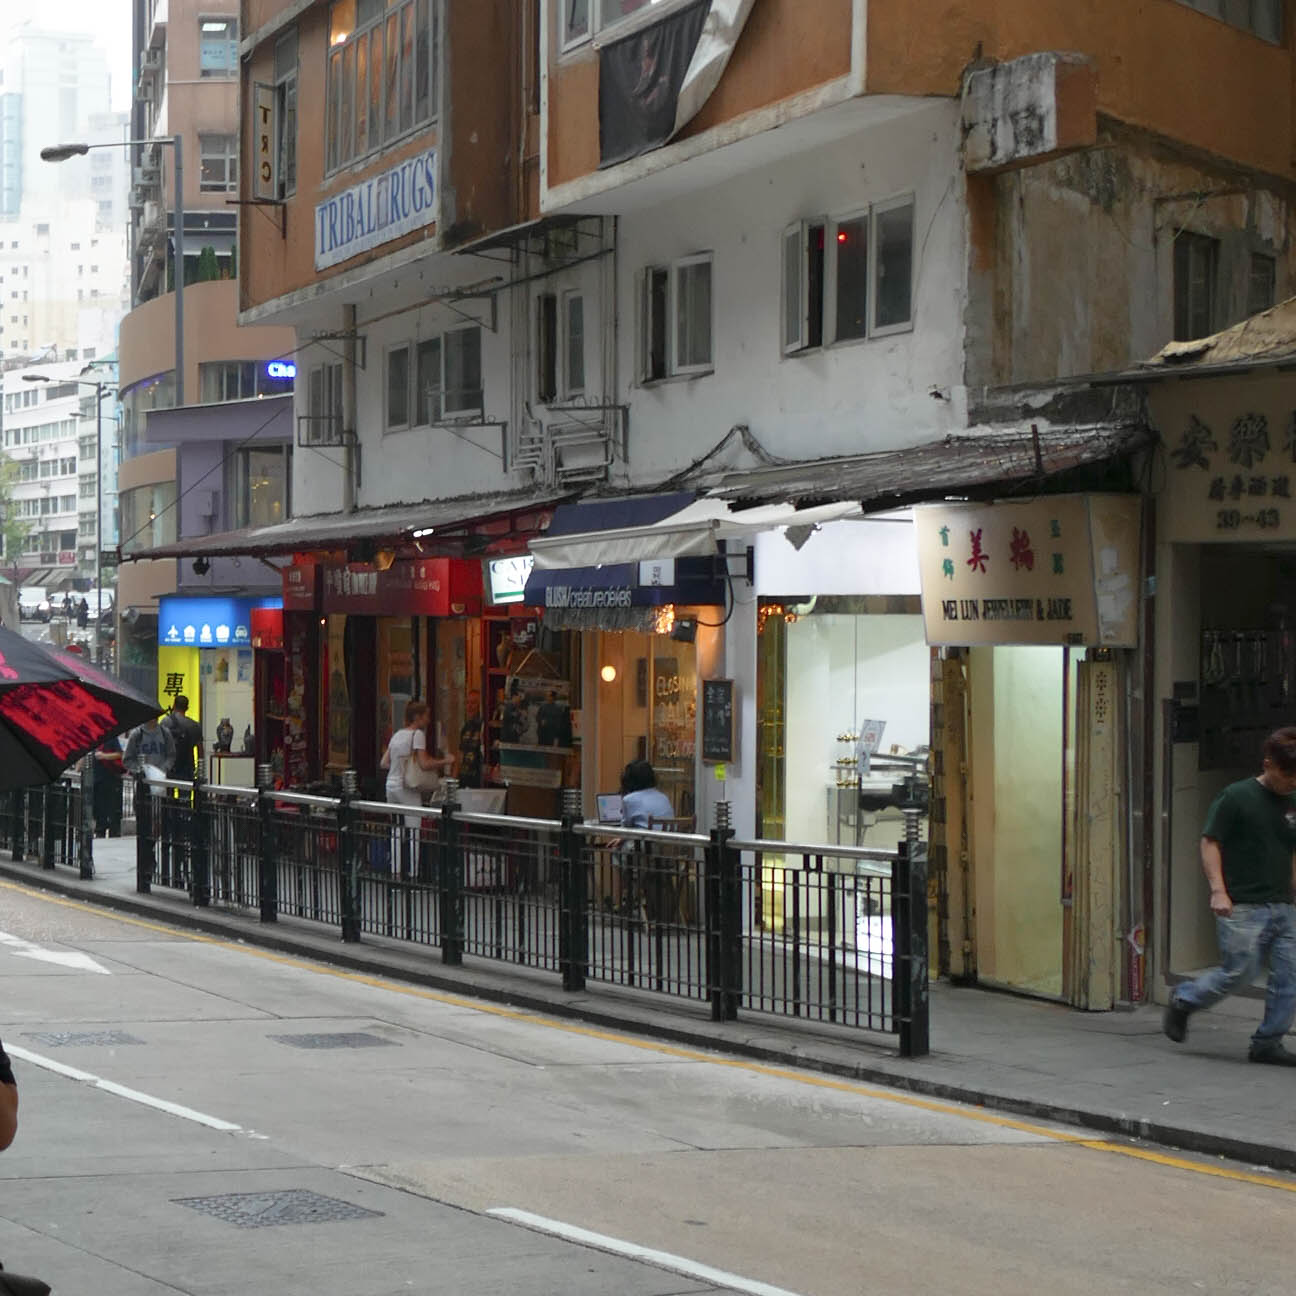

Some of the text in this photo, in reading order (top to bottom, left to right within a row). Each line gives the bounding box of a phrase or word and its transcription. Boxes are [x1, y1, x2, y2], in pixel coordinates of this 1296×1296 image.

[317, 151, 435, 255] TRIBAL RUGS
[1170, 409, 1296, 471] 安樂
[942, 600, 958, 621] MEI
[960, 599, 979, 621] LUN
[1047, 597, 1073, 621] JADE
[163, 672, 185, 697] 專
